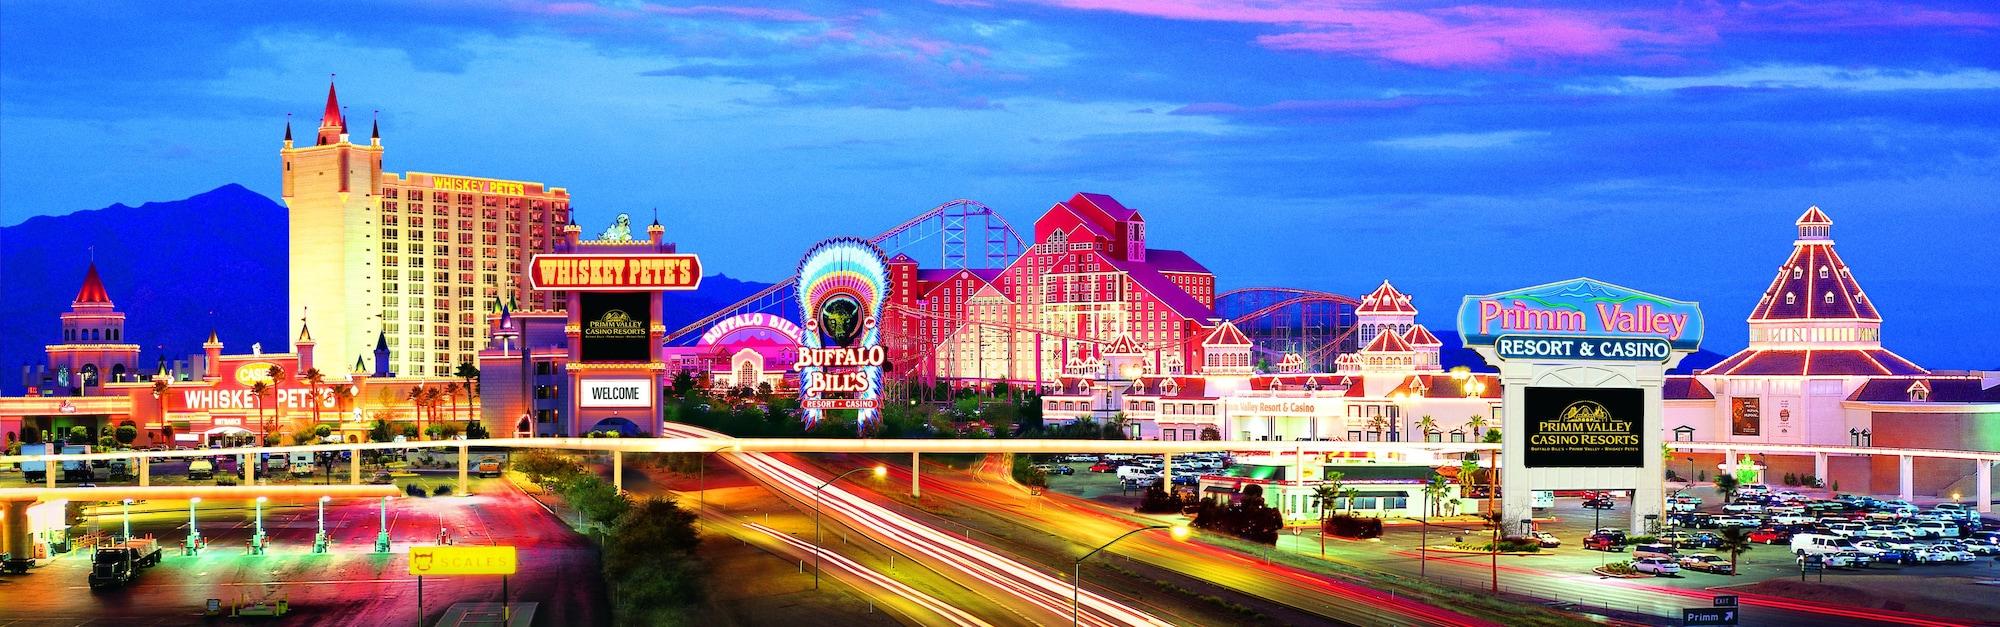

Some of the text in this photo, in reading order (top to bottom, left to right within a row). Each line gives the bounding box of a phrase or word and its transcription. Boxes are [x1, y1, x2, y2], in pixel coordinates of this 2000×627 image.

[433, 177, 525, 195] WHISKEY PETE'S
[539, 259, 690, 285] WHISKEY PETE'S
[703, 312, 763, 345] BUFFALO
[1479, 300, 1688, 340] Primm Valley
[1500, 339, 1669, 358] RESORT & CASINO
[793, 345, 884, 371] BUFFALO
[807, 371, 869, 397] BILL'S
[592, 387, 639, 400] WELCOME
[1259, 402, 1281, 411] Resort
[1283, 402, 1288, 411] &
[1290, 402, 1315, 412] Casino
[1539, 422, 1632, 431] PRIMM VALLEY
[1531, 435, 1639, 445] CASINO RESORTS
[441, 557, 507, 568] SCALES
[1688, 613, 1719, 621] Primm
